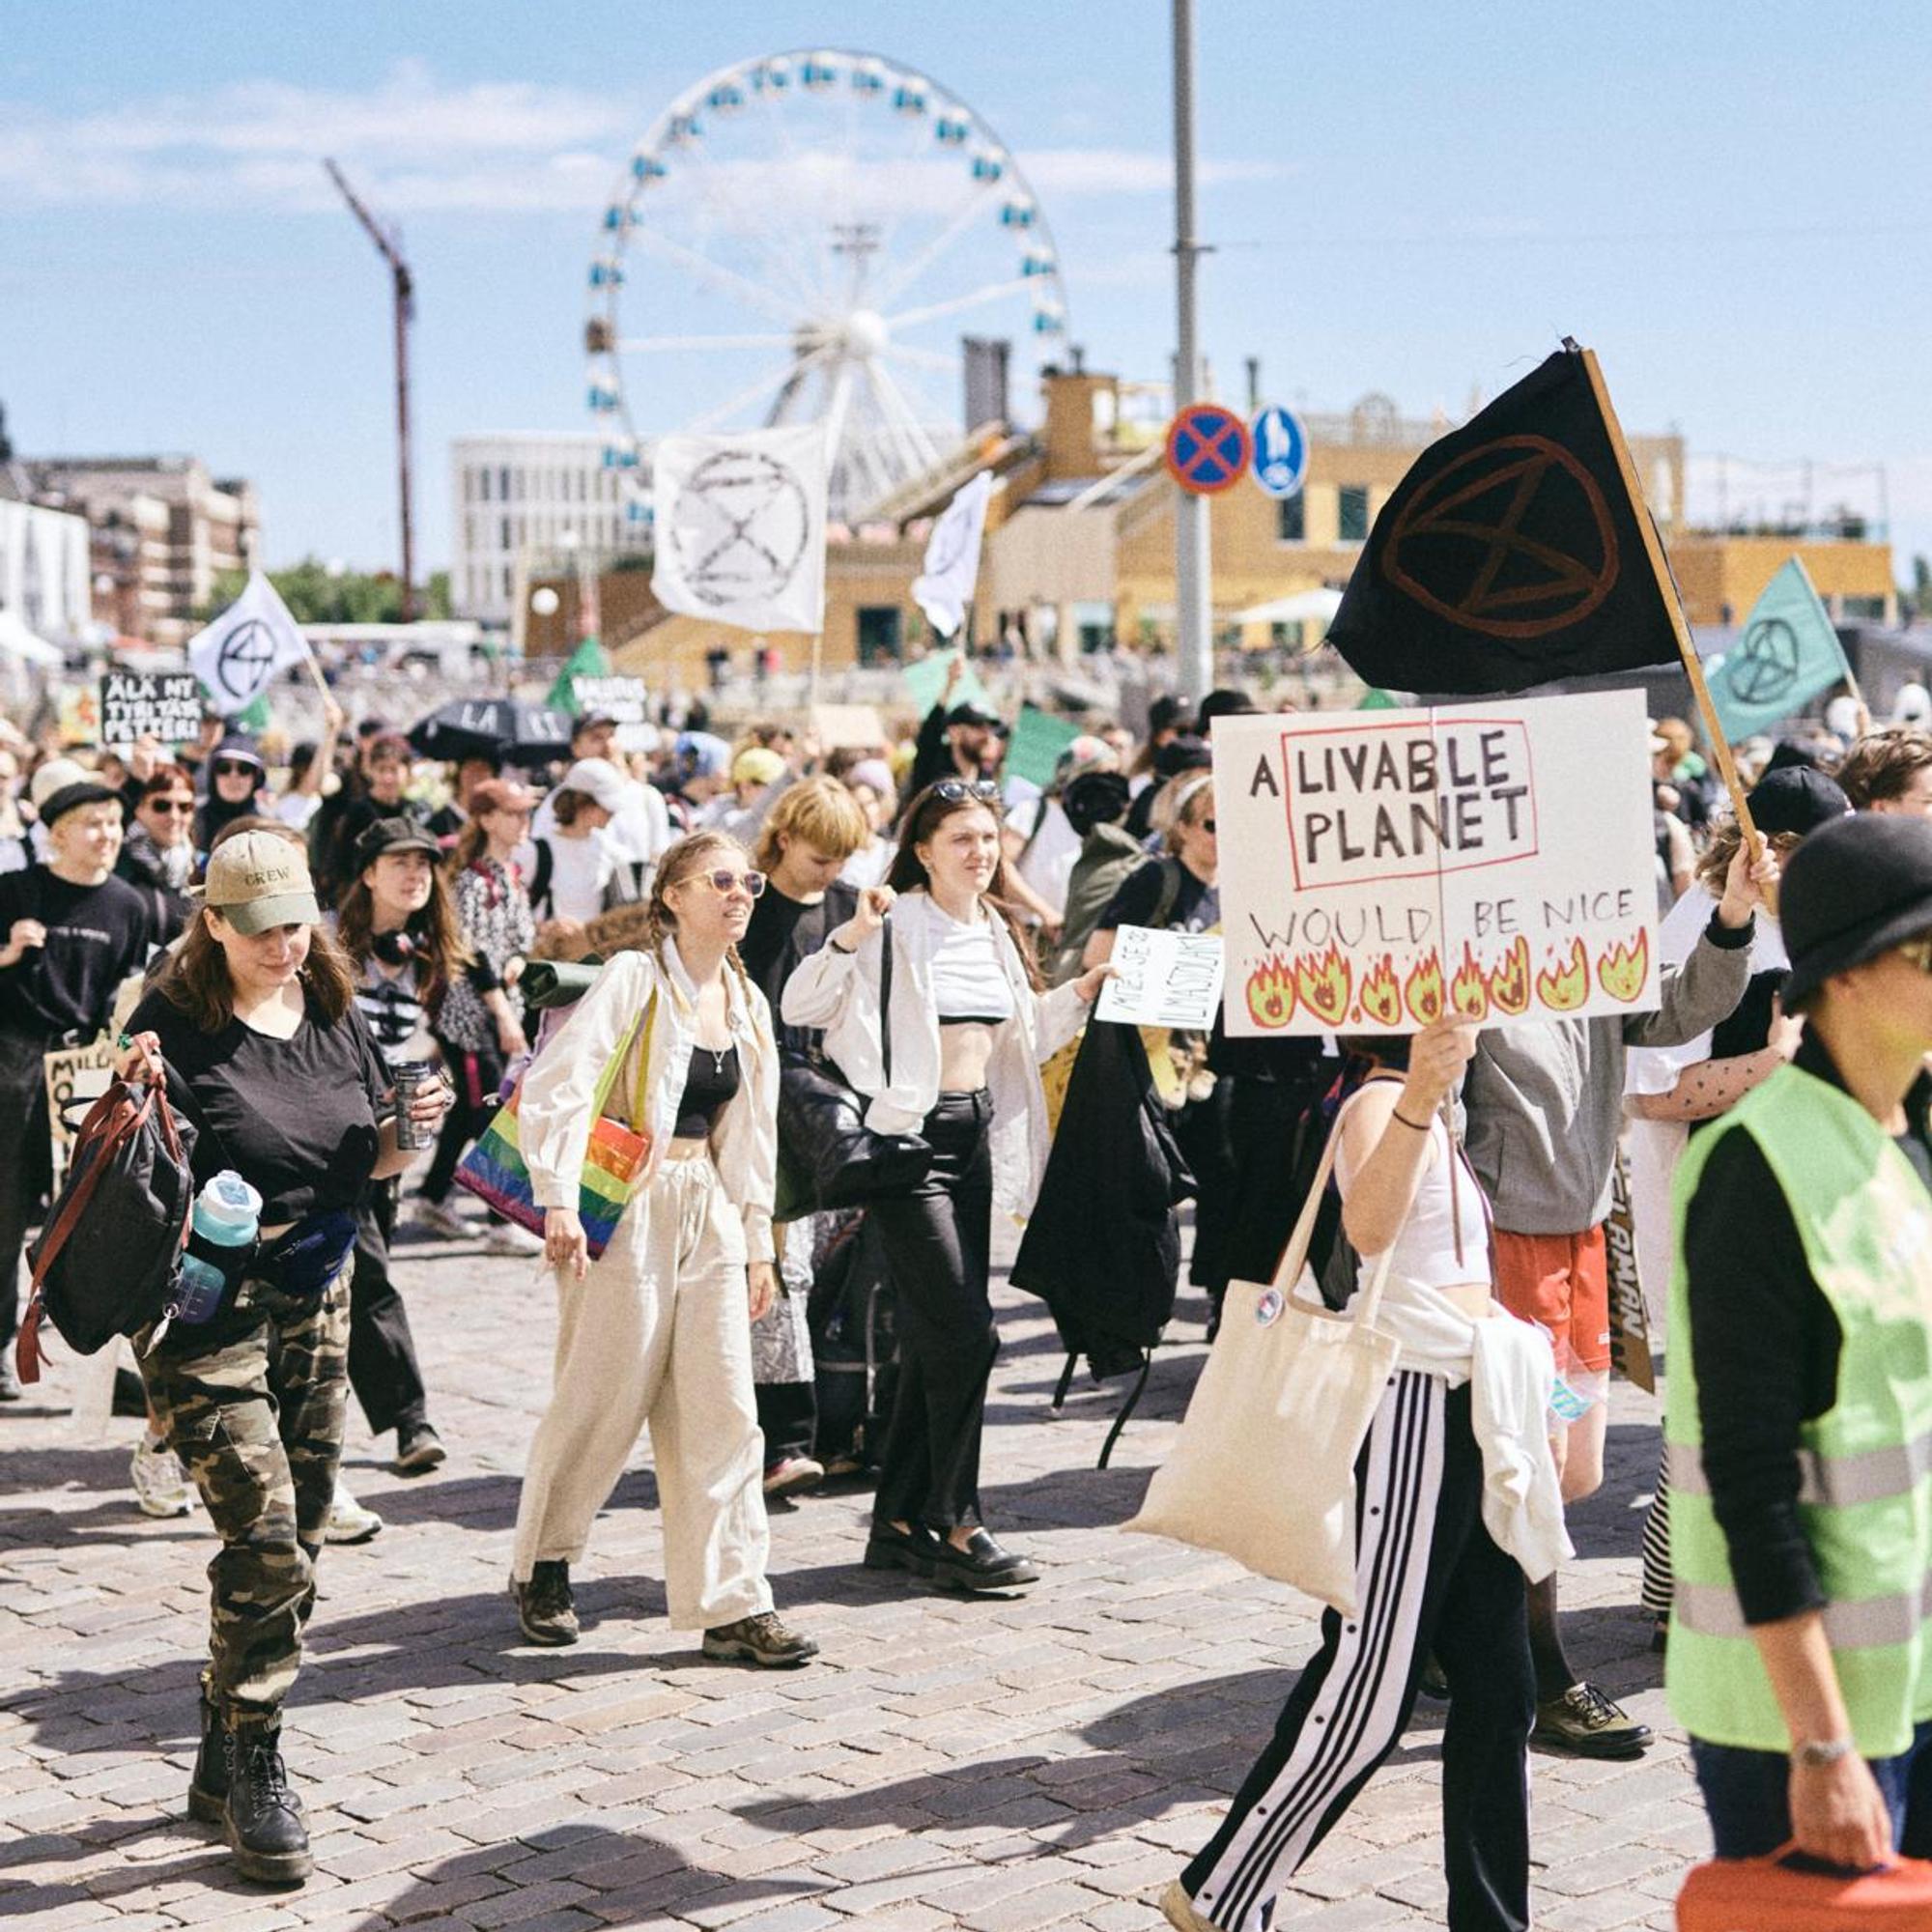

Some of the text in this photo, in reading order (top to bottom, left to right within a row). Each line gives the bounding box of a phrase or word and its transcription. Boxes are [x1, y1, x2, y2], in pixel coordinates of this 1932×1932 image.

[106, 674, 157, 699] ÄLÄ
[1250, 729, 1510, 798] A LIVABLE
[1305, 786, 1528, 864] PLANET
[245, 866, 290, 886] CREW
[1249, 905, 1433, 949] WOULD
[1474, 898, 1520, 937] BE
[1545, 889, 1634, 930] NICE
